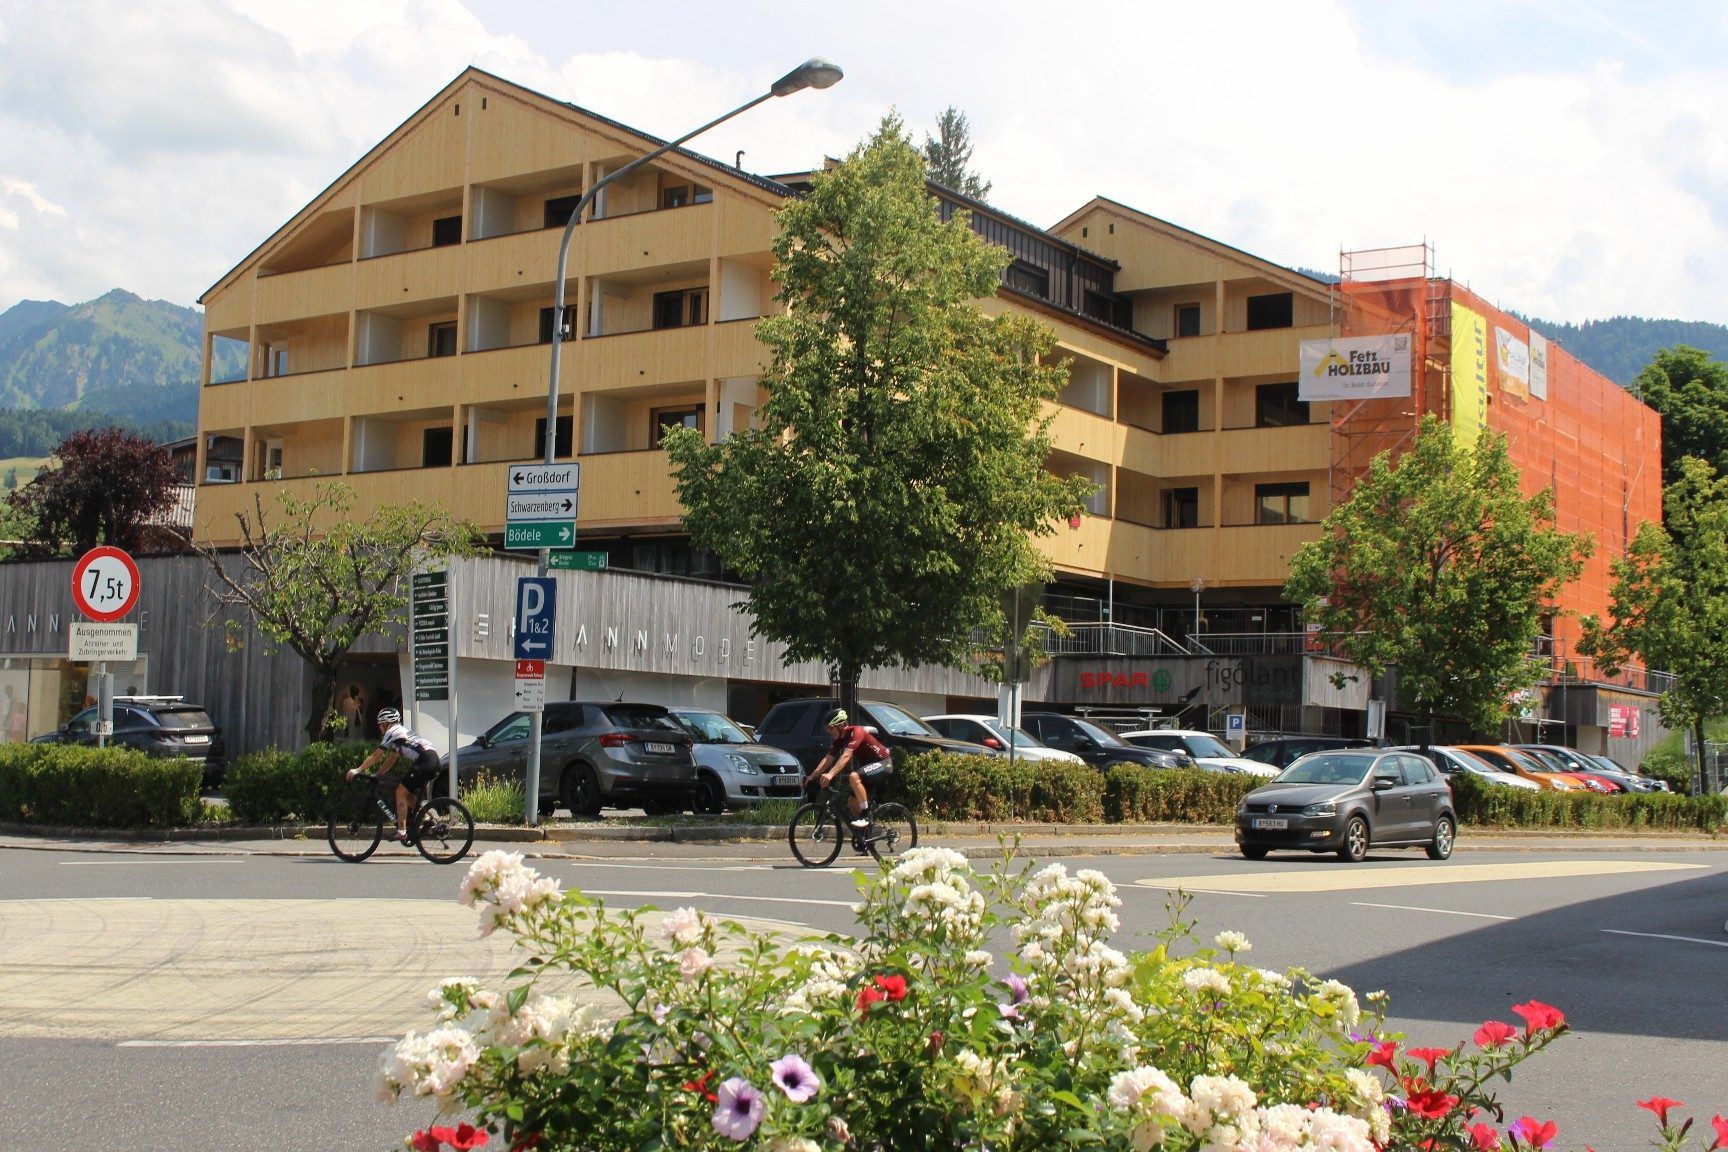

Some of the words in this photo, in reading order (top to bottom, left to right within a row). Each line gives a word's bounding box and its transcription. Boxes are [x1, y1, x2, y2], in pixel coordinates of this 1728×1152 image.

[1349, 350, 1377, 363] Fetz
[1328, 362, 1391, 377] HOLZBAU
[526, 471, 571, 484] Großdorf
[510, 499, 560, 514] Schwarzenberg
[508, 527, 541, 541] Bödele
[88, 569, 124, 603] 7,5t
[520, 582, 545, 634] P
[529, 619, 549, 634] 1&2
[76, 628, 132, 640] Ausgenommen
[78, 649, 128, 658] Zubringerverkehr
[1080, 672, 1149, 688] SPAR
[1232, 717, 1240, 728] P
